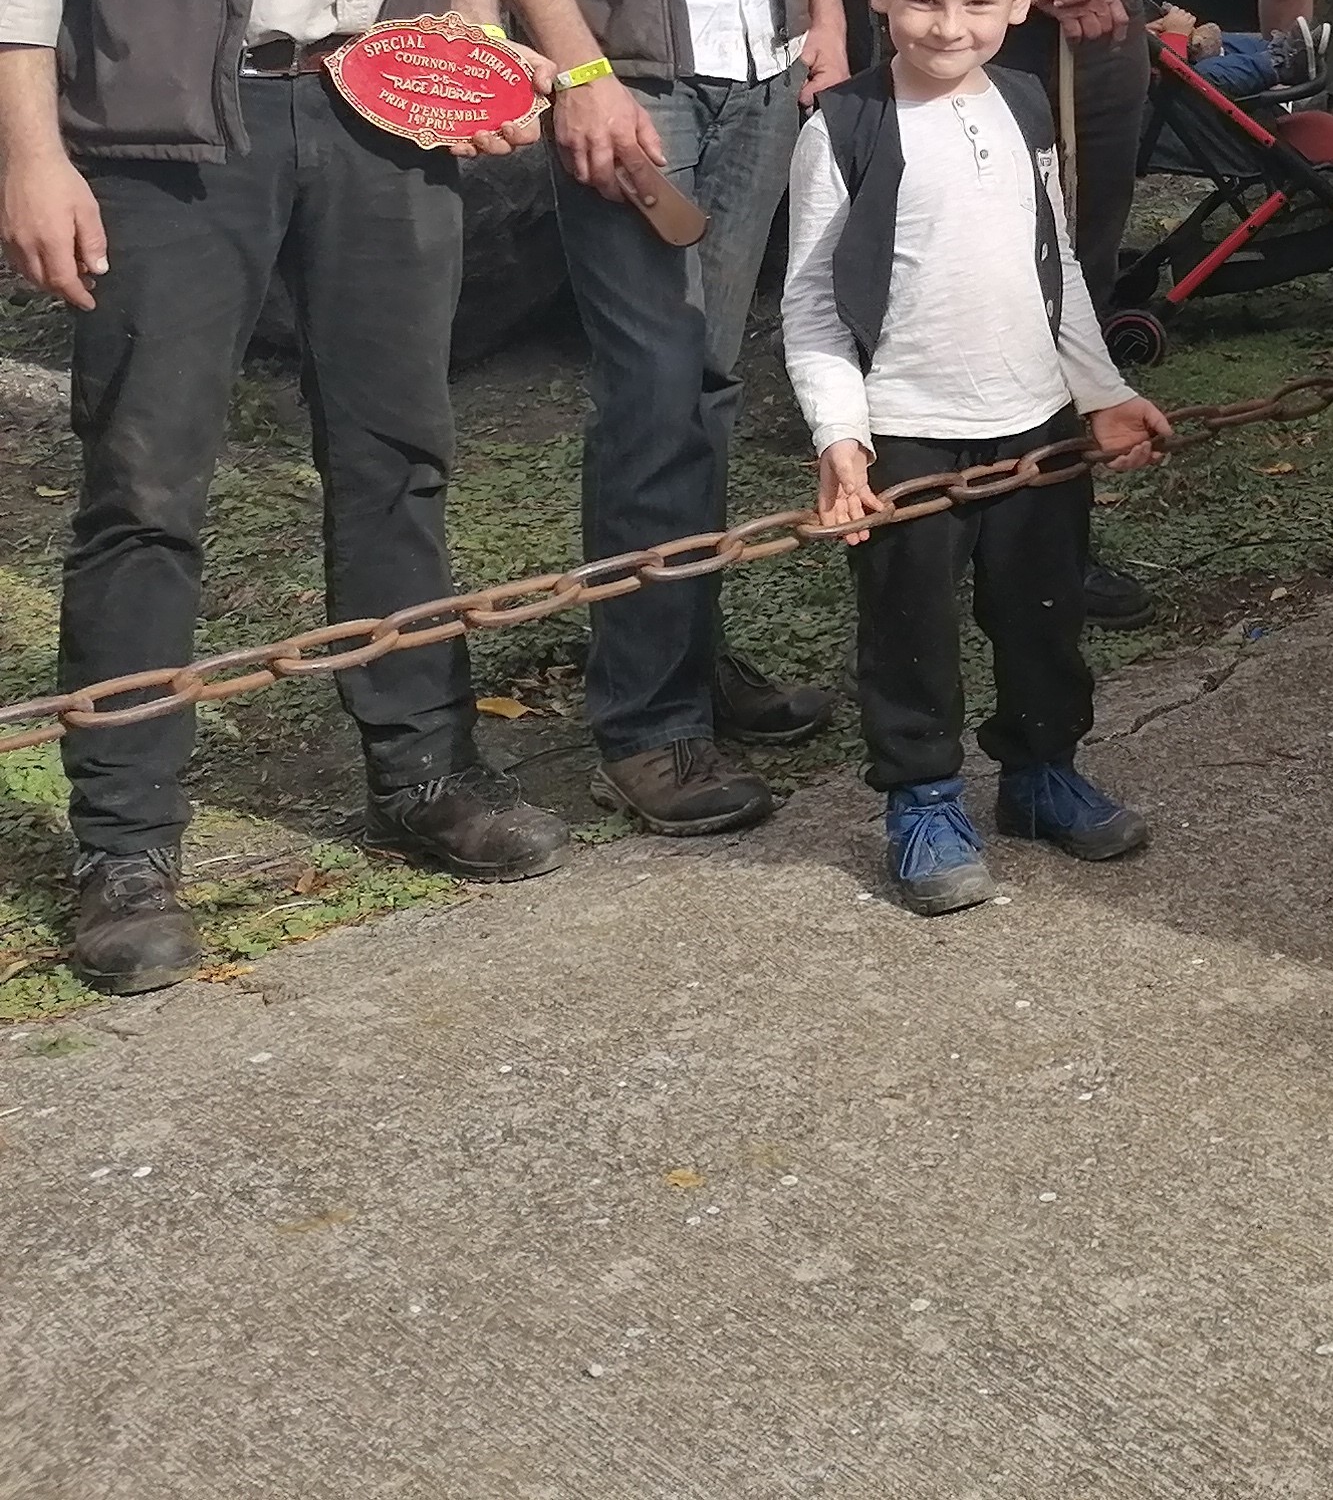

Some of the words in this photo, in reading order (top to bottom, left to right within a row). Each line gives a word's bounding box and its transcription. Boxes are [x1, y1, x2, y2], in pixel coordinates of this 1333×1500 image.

[363, 34, 426, 57] SPECIAL
[467, 47, 521, 86] AUBRAC
[377, 88, 409, 110] PRIX
[410, 102, 489, 122] D'ENSEMBLE
[429, 83, 482, 104] AUBRAC
